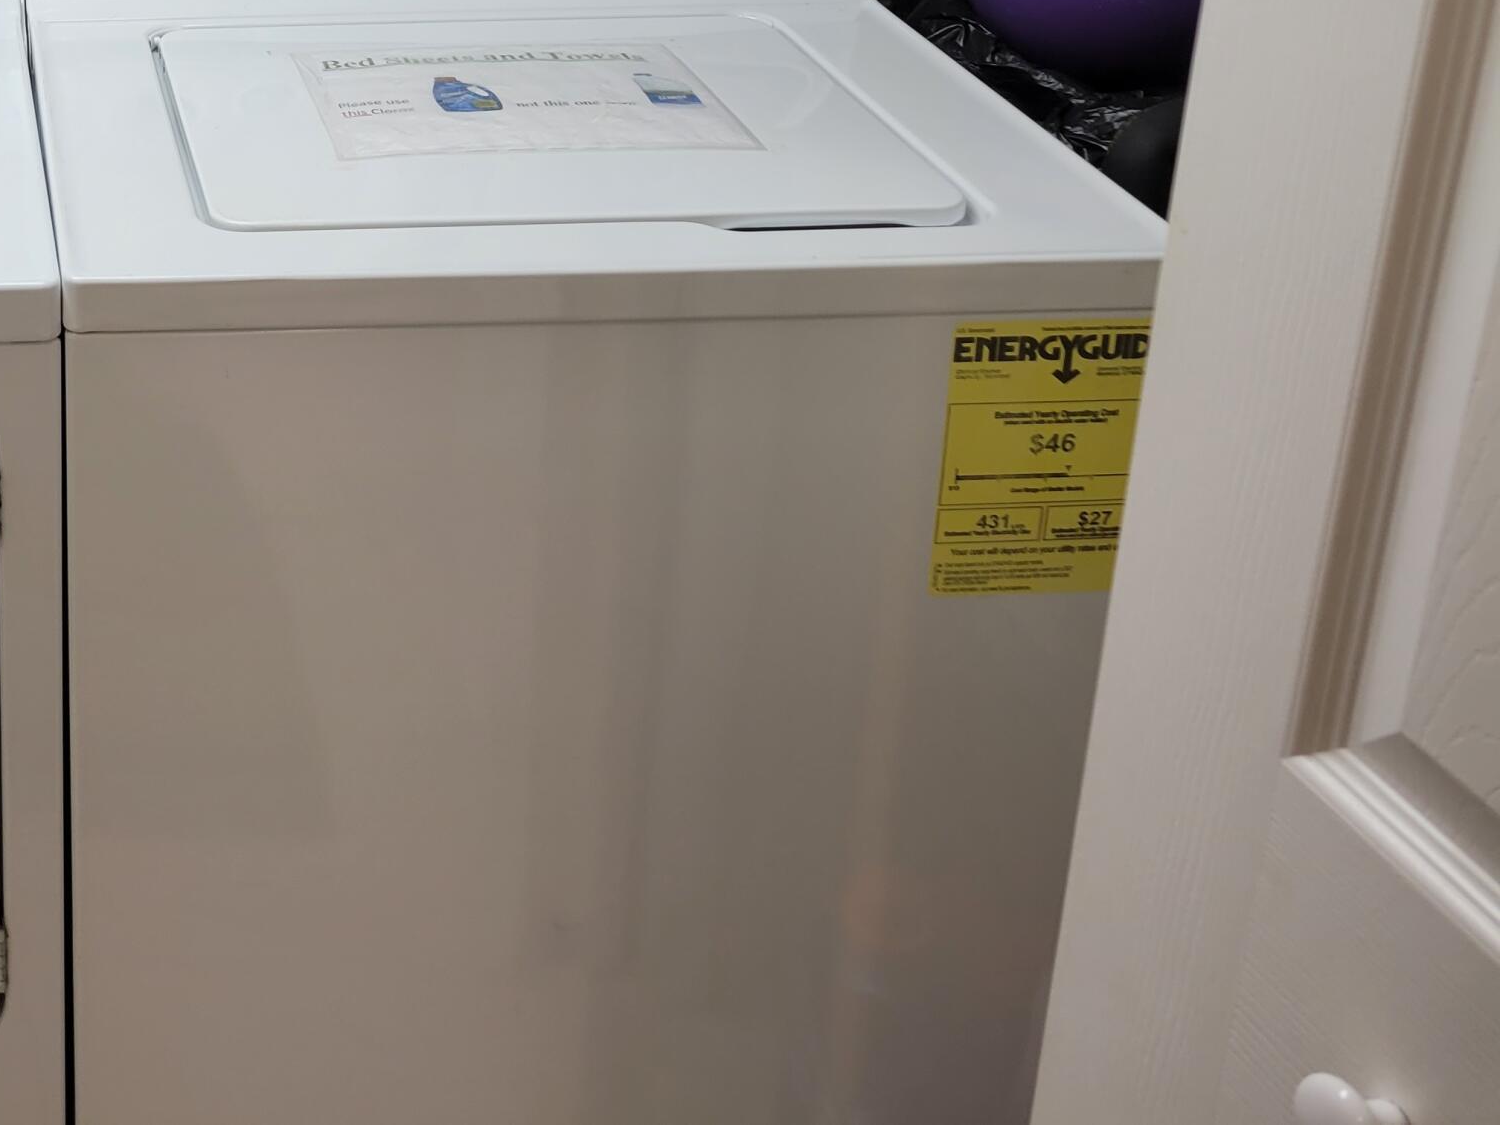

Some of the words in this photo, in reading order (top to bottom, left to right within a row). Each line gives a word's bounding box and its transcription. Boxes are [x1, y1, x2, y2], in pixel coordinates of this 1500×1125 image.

[321, 57, 374, 71] Bed
[384, 52, 472, 67] Sheets
[485, 50, 533, 62] and
[547, 49, 647, 62] Towels
[338, 100, 382, 109] Please
[543, 99, 570, 107] this
[953, 332, 1152, 368] ENERGYGUID
[1033, 410, 1060, 420] Yearly
[1060, 409, 1099, 420] Operating
[1100, 408, 1119, 416] Cost
[1029, 432, 1076, 455] $46
[976, 514, 1009, 529] 431
[1077, 510, 1113, 528] $27
[950, 548, 969, 556] Your
[999, 547, 1027, 556] depend
